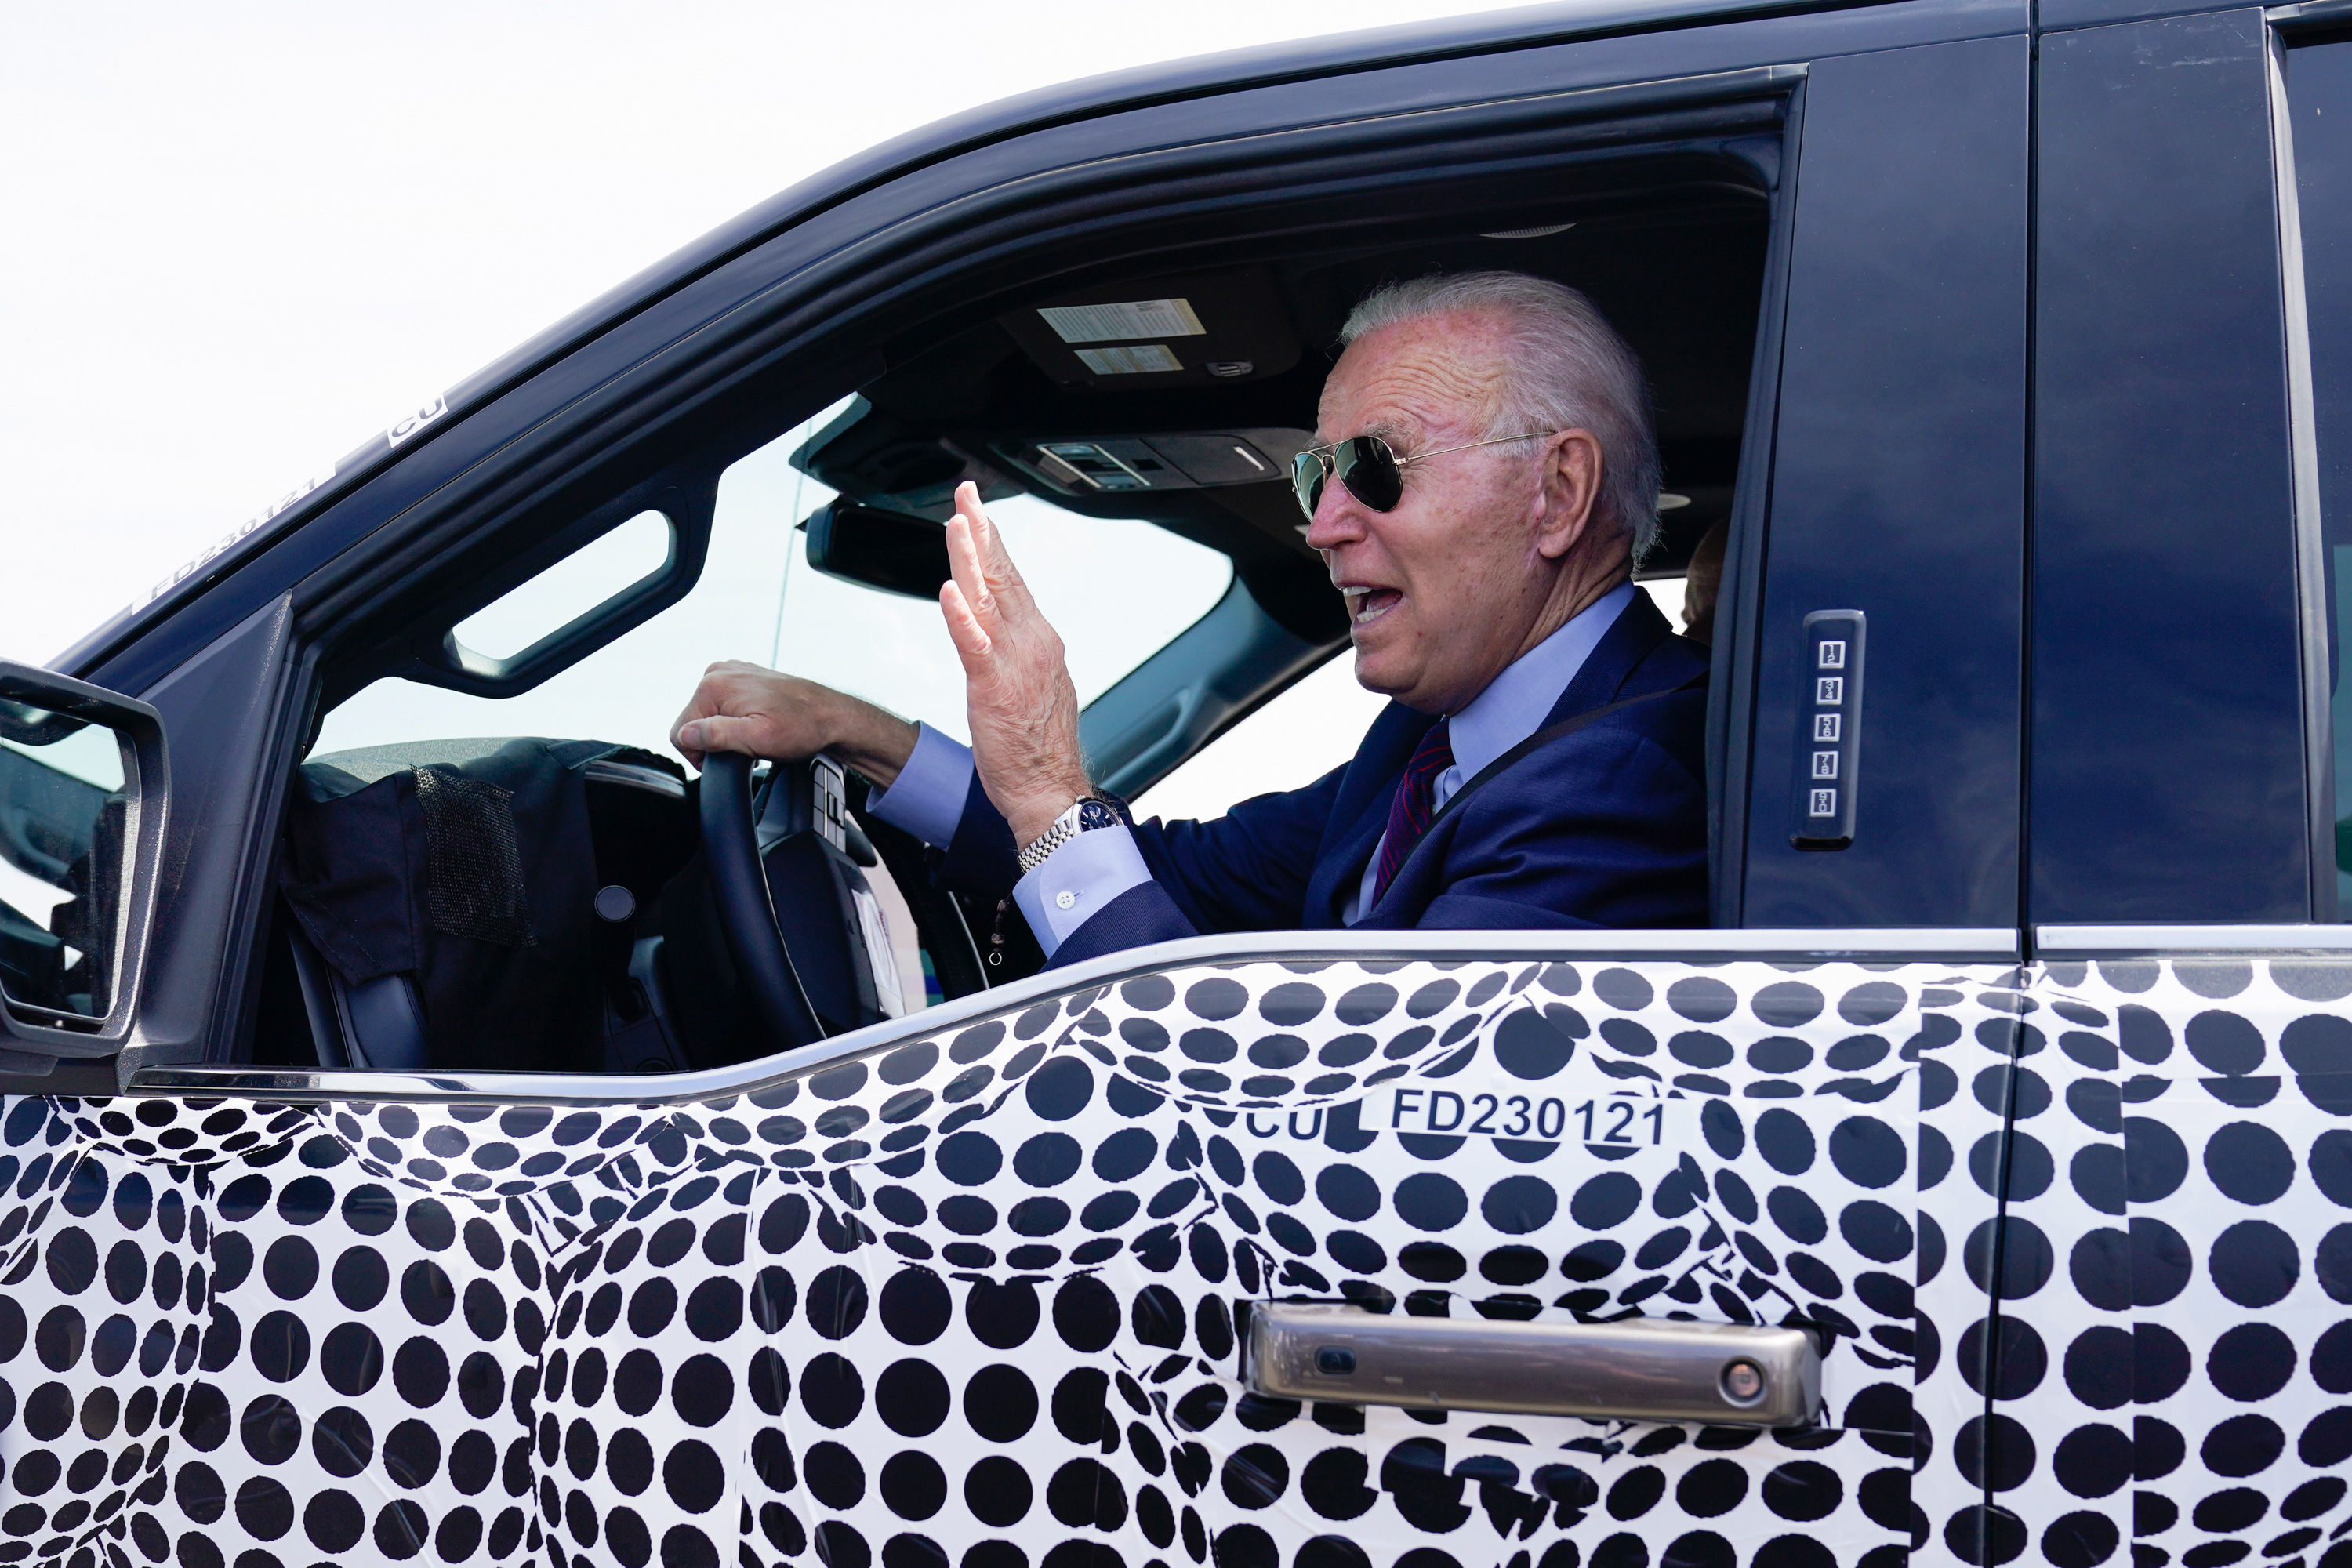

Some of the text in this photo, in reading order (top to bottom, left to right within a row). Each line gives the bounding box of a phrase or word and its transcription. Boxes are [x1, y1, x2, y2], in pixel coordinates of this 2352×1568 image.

[151, 395, 443, 601] FD230121 CU
[1246, 1088, 1664, 1145] CU FD230121
